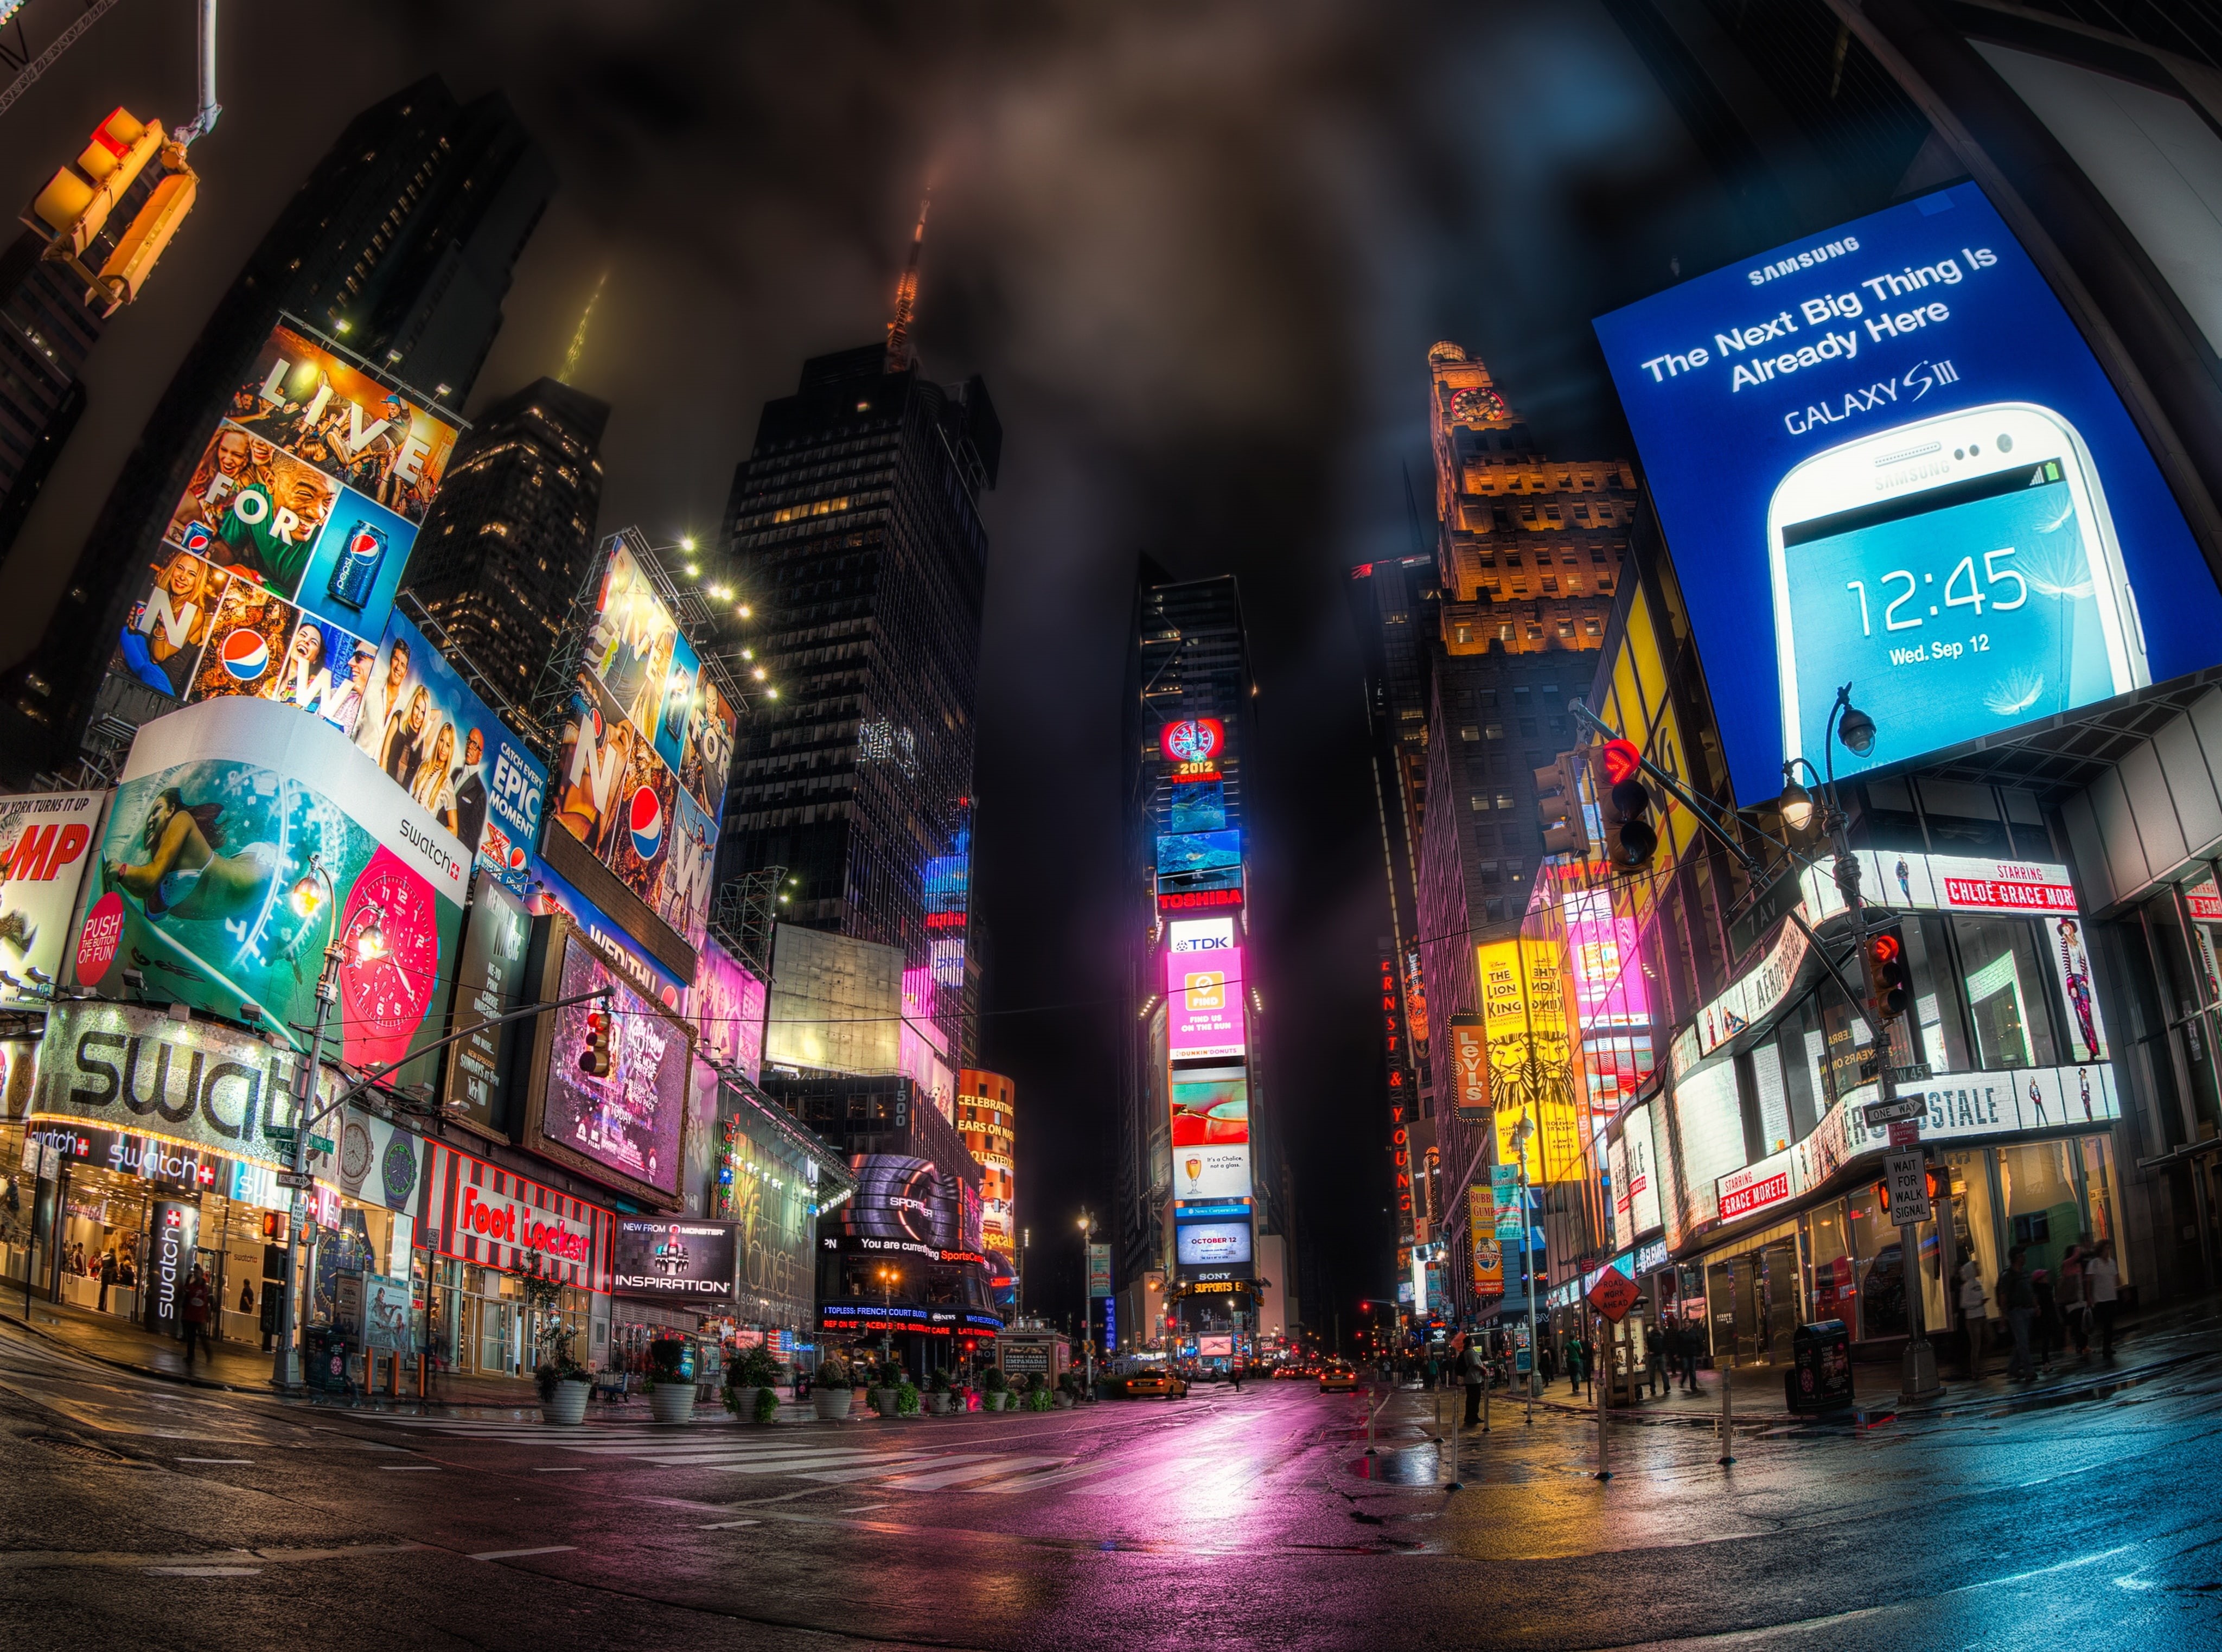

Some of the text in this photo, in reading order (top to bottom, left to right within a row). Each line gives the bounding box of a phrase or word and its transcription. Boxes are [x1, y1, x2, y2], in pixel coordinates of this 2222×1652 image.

[1747, 236, 1860, 286] SAMSUNG
[1640, 246, 1998, 382] The Next Big Thing Is
[1732, 301, 1950, 393] Already Here
[1785, 378, 1898, 436] GALAXY
[259, 359, 430, 484] LIVE
[1875, 460, 1950, 490] SAMSUNG
[205, 473, 300, 545] FOR
[336, 557, 353, 590] pepsi
[1847, 546, 2028, 636] 12:45
[1889, 634, 1990, 667] Wed. Sep 12
[692, 709, 732, 787] FOR
[501, 743, 543, 789] CATCH EVERY
[1180, 762, 1214, 774] 2012
[1172, 771, 1222, 783] TOSHIBA
[493, 755, 541, 823] EPIC
[10, 798, 90, 813] YORK TURNS IT UP
[489, 790, 534, 839] MOMENT
[399, 819, 452, 874] swatch
[1997, 865, 2044, 881] STARRING
[1159, 890, 1242, 909] TOSHIBA
[1950, 881, 2044, 905] CHLOË GRACE
[84, 914, 122, 939] PUSH
[1747, 915, 1755, 936] 7
[82, 936, 116, 948] THE BUTTON
[493, 923, 521, 961] MUSIC
[1188, 937, 1228, 949] TDK
[78, 948, 113, 964] OF FUN
[488, 962, 502, 981] NE-YO
[1489, 970, 1510, 981] THE
[482, 991, 499, 1009] CARRIE
[1487, 984, 1516, 999] LION
[1193, 997, 1218, 1007] FIND
[1487, 1002, 1521, 1019] KING
[1211, 1014, 1222, 1022] US
[468, 1049, 476, 1059] NEW
[460, 1053, 484, 1078] SUNDAYS
[1896, 1067, 1924, 1082] W 45
[896, 1078, 907, 1127] 1500
[958, 1095, 1013, 1117] CELEBRATING
[1873, 1102, 1916, 1120] ONE WAY
[610, 1102, 633, 1125] TODAY
[265, 1126, 279, 1134] GEORGE
[988, 1125, 1001, 1136] ON
[276, 1141, 292, 1153] W 45
[588, 1139, 601, 1150] FILMS
[108, 1144, 197, 1182] swatch
[981, 1151, 1008, 1166] LISTED
[1393, 1107, 1411, 1211] YOUNG
[1893, 1159, 1917, 1173] WAIT
[281, 1175, 308, 1185] ONE WAY
[1725, 1171, 1752, 1193] STARRING
[1898, 1176, 1918, 1188] FOR
[1726, 1177, 1787, 1215] GRACE MORETZ
[1895, 1191, 1923, 1202] WALK
[1473, 1205, 1495, 1217] GUMP
[1896, 1206, 1926, 1219] SIGNAL
[463, 1186, 590, 1262] Foot Locker
[623, 1222, 725, 1236] NEW FROM MONSTER
[861, 1238, 899, 1249] You are
[234, 1254, 254, 1263] swatch
[159, 1227, 180, 1319] swatch
[616, 1275, 731, 1293] INSPIRATION
[1195, 1283, 1233, 1293] SUPPORTS
[1604, 1279, 1624, 1288] ROAD
[828, 1306, 911, 1317] TOPLESS: FRENCH COURT
[1602, 1299, 1628, 1310] AHEAD
[824, 1320, 837, 1328] REF
